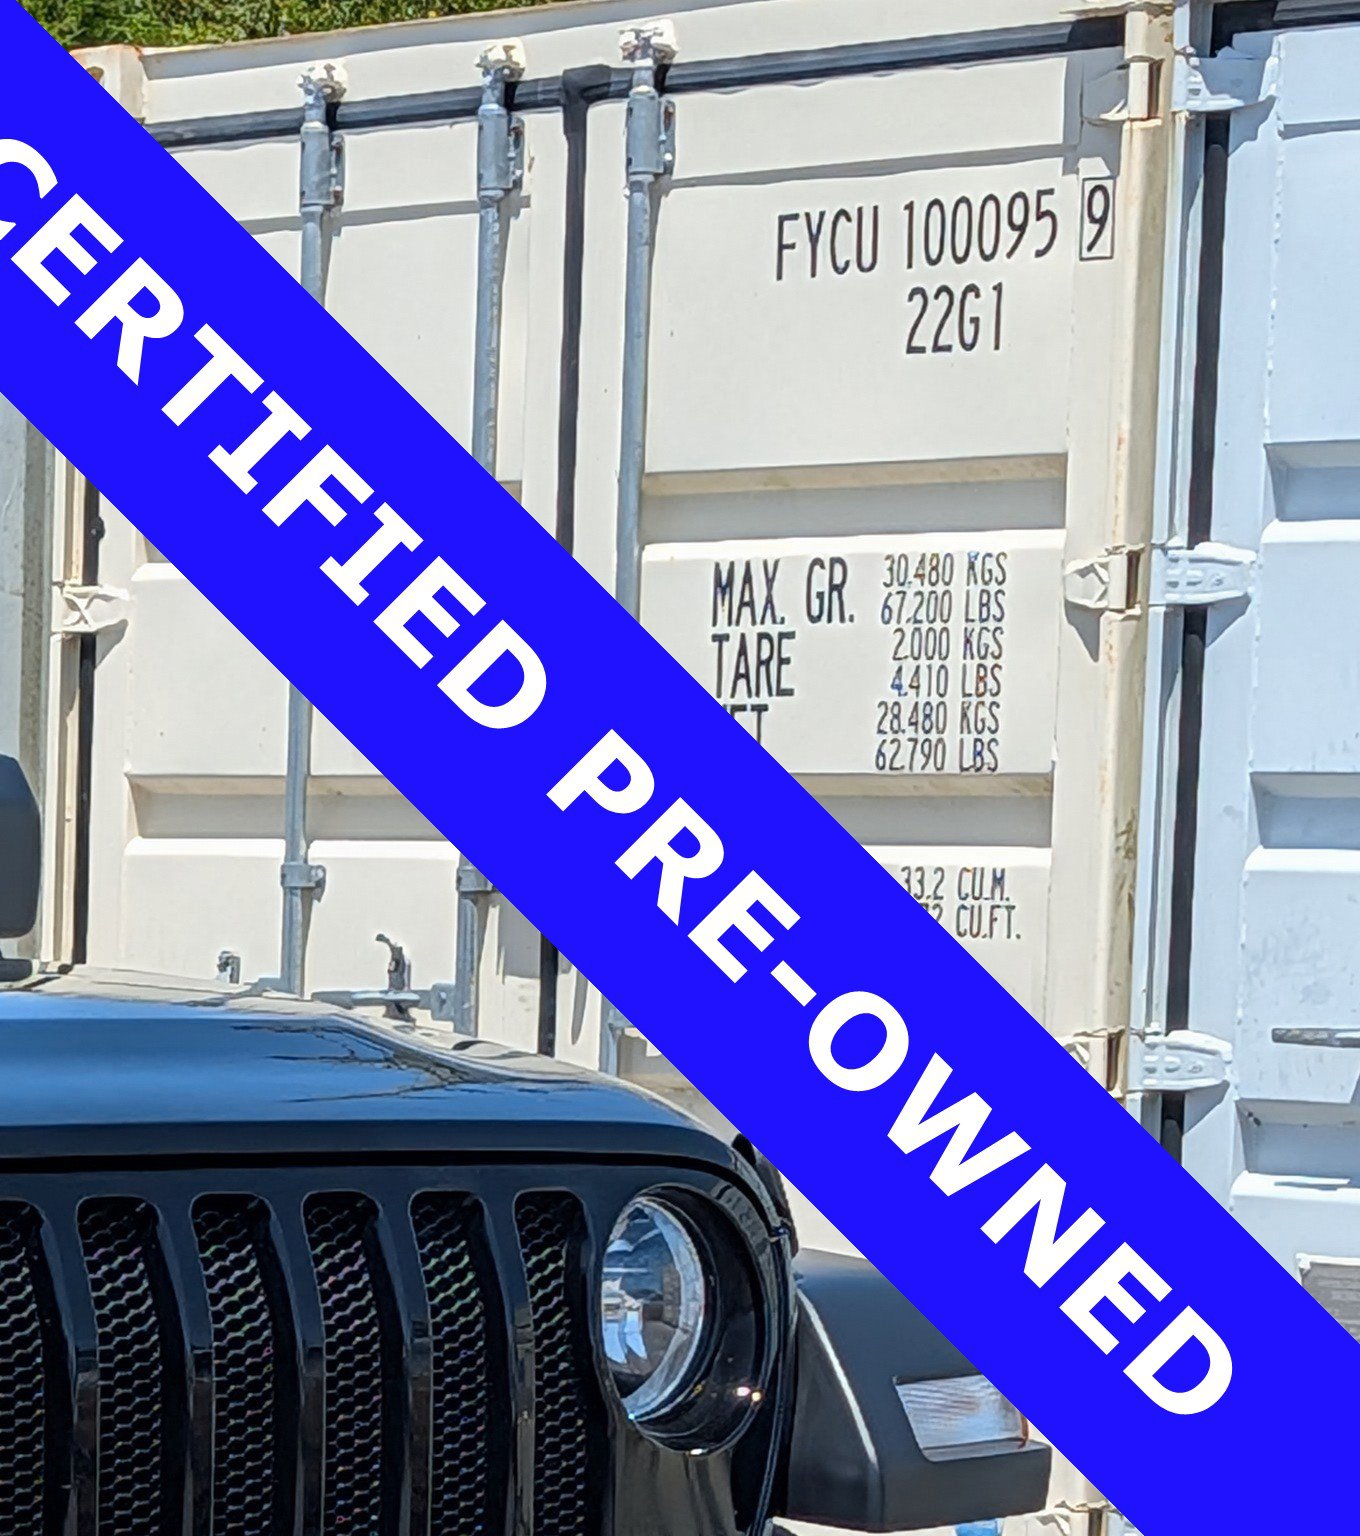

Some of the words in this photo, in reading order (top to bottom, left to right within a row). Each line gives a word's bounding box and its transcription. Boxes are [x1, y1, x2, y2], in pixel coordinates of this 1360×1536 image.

[776, 204, 879, 281] FYCU
[902, 188, 1058, 269] 100095
[1086, 183, 1112, 253] 9
[905, 282, 1003, 355] 22G1
[711, 557, 786, 628] MAX.
[805, 556, 855, 625] GR.
[882, 552, 954, 588] 30.480
[966, 551, 1008, 587] KGS
[880, 589, 953, 626] 67.200
[964, 588, 1006, 624] LBS
[711, 630, 796, 699] TARE
[962, 626, 1004, 661] KGS
[961, 662, 1003, 698] LBS
[876, 700, 948, 735] 28.480
[959, 700, 1001, 735] KGS
[958, 737, 1000, 773] LBS
[900, 866, 946, 901] 33.2
